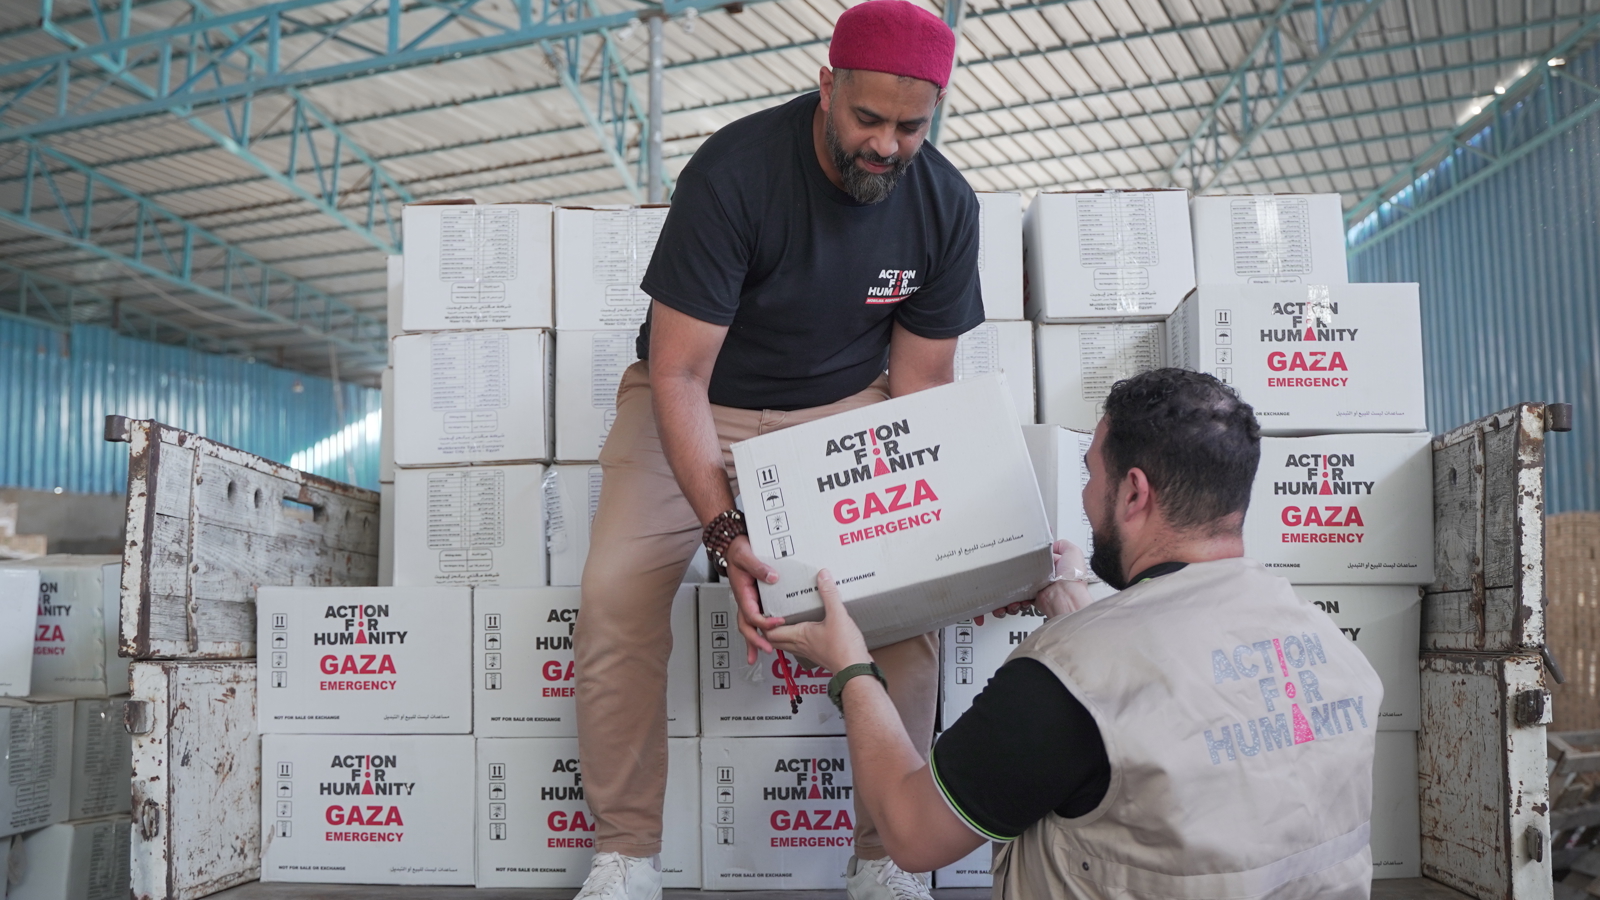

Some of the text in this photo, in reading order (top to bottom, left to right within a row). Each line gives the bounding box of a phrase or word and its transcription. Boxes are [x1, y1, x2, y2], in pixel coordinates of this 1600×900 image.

[879, 269, 916, 280] ACTION
[868, 286, 921, 296] HUMANITY
[889, 279, 908, 287] FOR
[1260, 326, 1358, 342] HUMANITY
[1267, 351, 1348, 371] GAZA
[1268, 378, 1348, 387] EMERGENCY
[825, 419, 911, 456] ACTION
[853, 440, 900, 465] FOR
[816, 444, 942, 492] HUMANITY
[1285, 454, 1354, 471] ACTION
[1308, 467, 1343, 481] FOR
[1274, 478, 1376, 496] HUMANITY
[833, 478, 938, 525] GAZA
[1281, 506, 1364, 527] GAZA
[839, 509, 943, 546] EMERGENCY
[1282, 533, 1364, 543] EMERGENCY
[842, 571, 876, 584] EXCHANGE
[38, 605, 71, 616] ANITY
[325, 605, 389, 620] ACTION
[35, 625, 65, 641] ZA
[345, 618, 378, 632] FOR
[314, 628, 407, 645] HUMANITY
[33, 647, 65, 655] GENCY
[1211, 632, 1327, 685] ACTION
[320, 654, 396, 675] GAZA
[320, 681, 396, 690] EMERGENCY
[1258, 670, 1324, 712] FOR
[1203, 695, 1368, 766] HUMANITY
[331, 755, 396, 771] ACTION
[775, 758, 844, 775] ACTION
[352, 768, 385, 782] FOR
[797, 772, 834, 787] FOR
[320, 779, 415, 795] HUMANITY
[764, 783, 853, 800] HUMANIT
[326, 805, 403, 826] GAZA
[770, 810, 854, 832] GAZA
[326, 832, 403, 842] EMERGENCY
[771, 836, 854, 847] EMERGENCY
